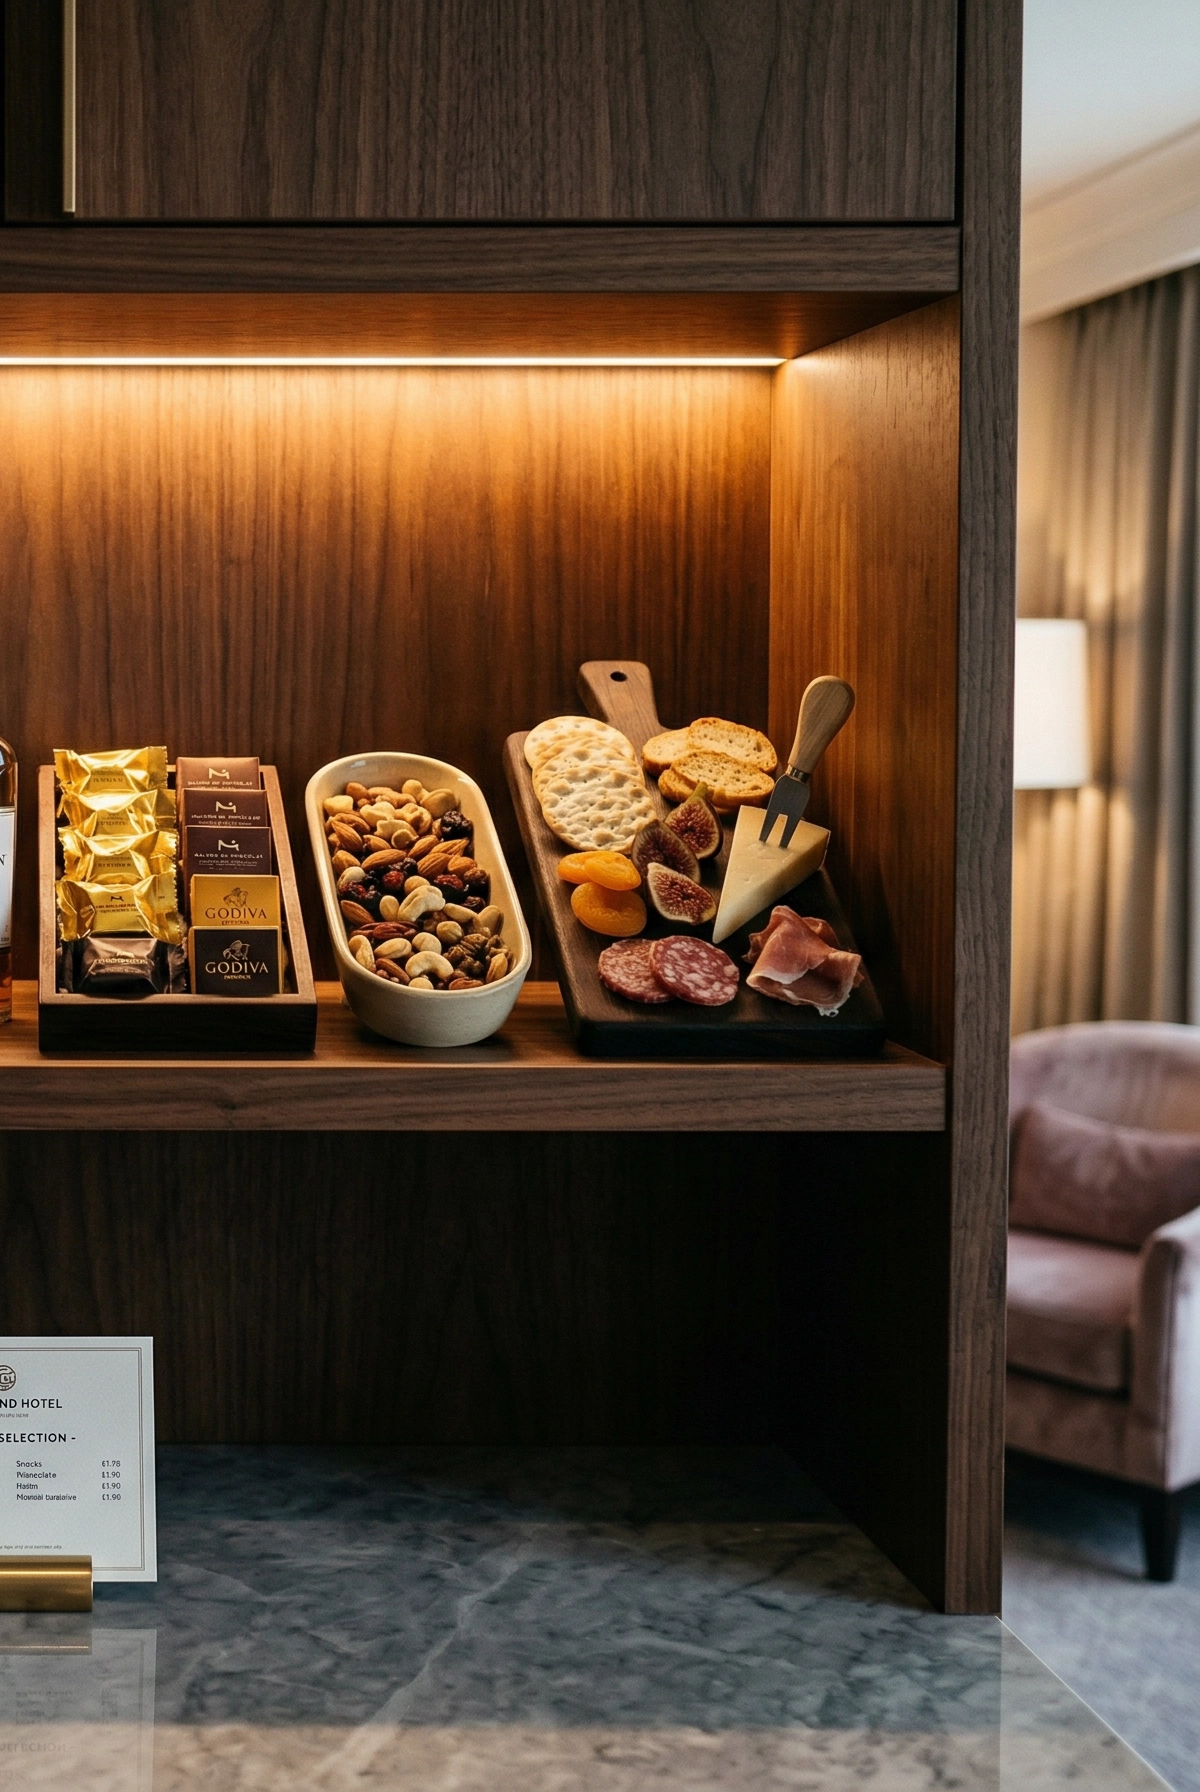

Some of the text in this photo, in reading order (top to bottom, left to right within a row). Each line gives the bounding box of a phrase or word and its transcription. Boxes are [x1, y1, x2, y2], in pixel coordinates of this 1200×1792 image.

[205, 907, 267, 919] GODIVA
[205, 961, 269, 974] GODIVA
[21, 1398, 63, 1409] HOTEL
[16, 1460, 42, 1468] Snacks
